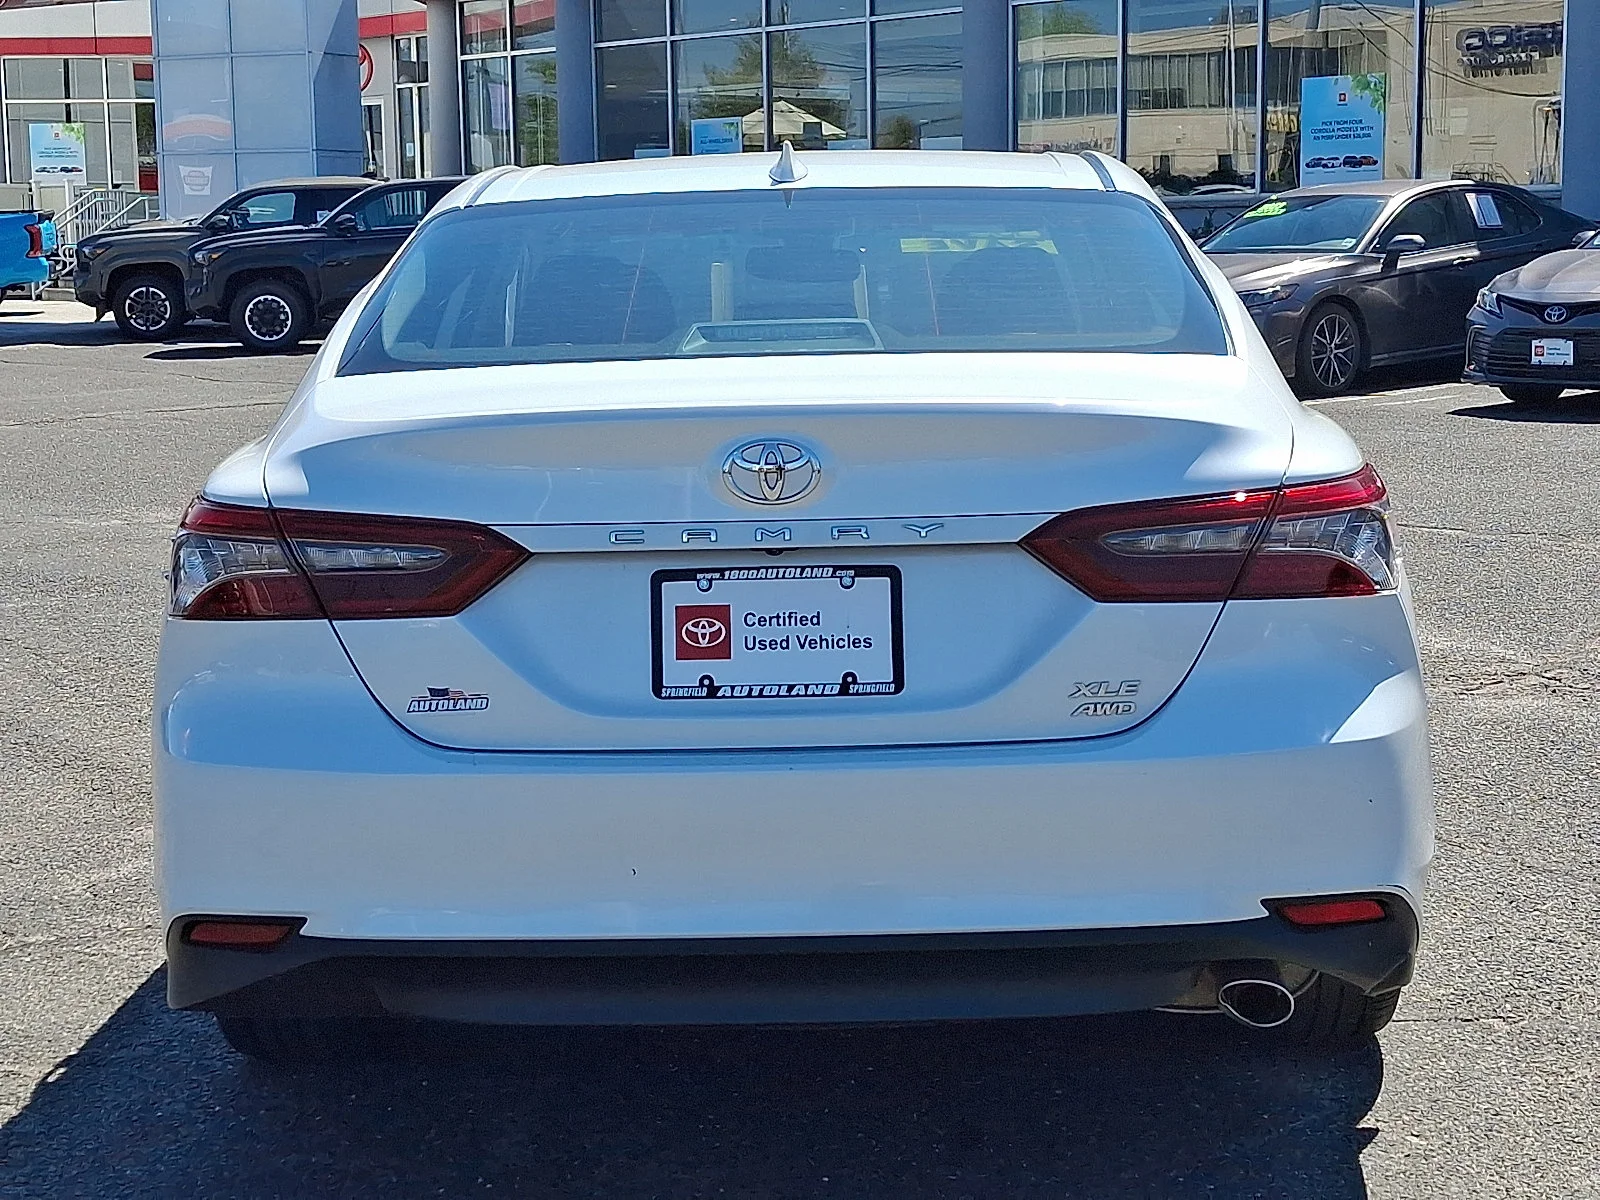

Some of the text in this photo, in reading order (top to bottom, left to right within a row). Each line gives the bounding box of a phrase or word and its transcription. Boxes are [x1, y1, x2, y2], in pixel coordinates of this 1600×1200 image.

[609, 522, 944, 544] CAMRY
[743, 610, 821, 628] Certified
[744, 633, 873, 651] Used Vehicles
[661, 683, 895, 697] SPRINGFIELD AUTOLAND SPRINGFIELD
[1068, 680, 1141, 698] XLE
[408, 699, 488, 712] AUTOLAND
[1070, 701, 1136, 717] AWD
